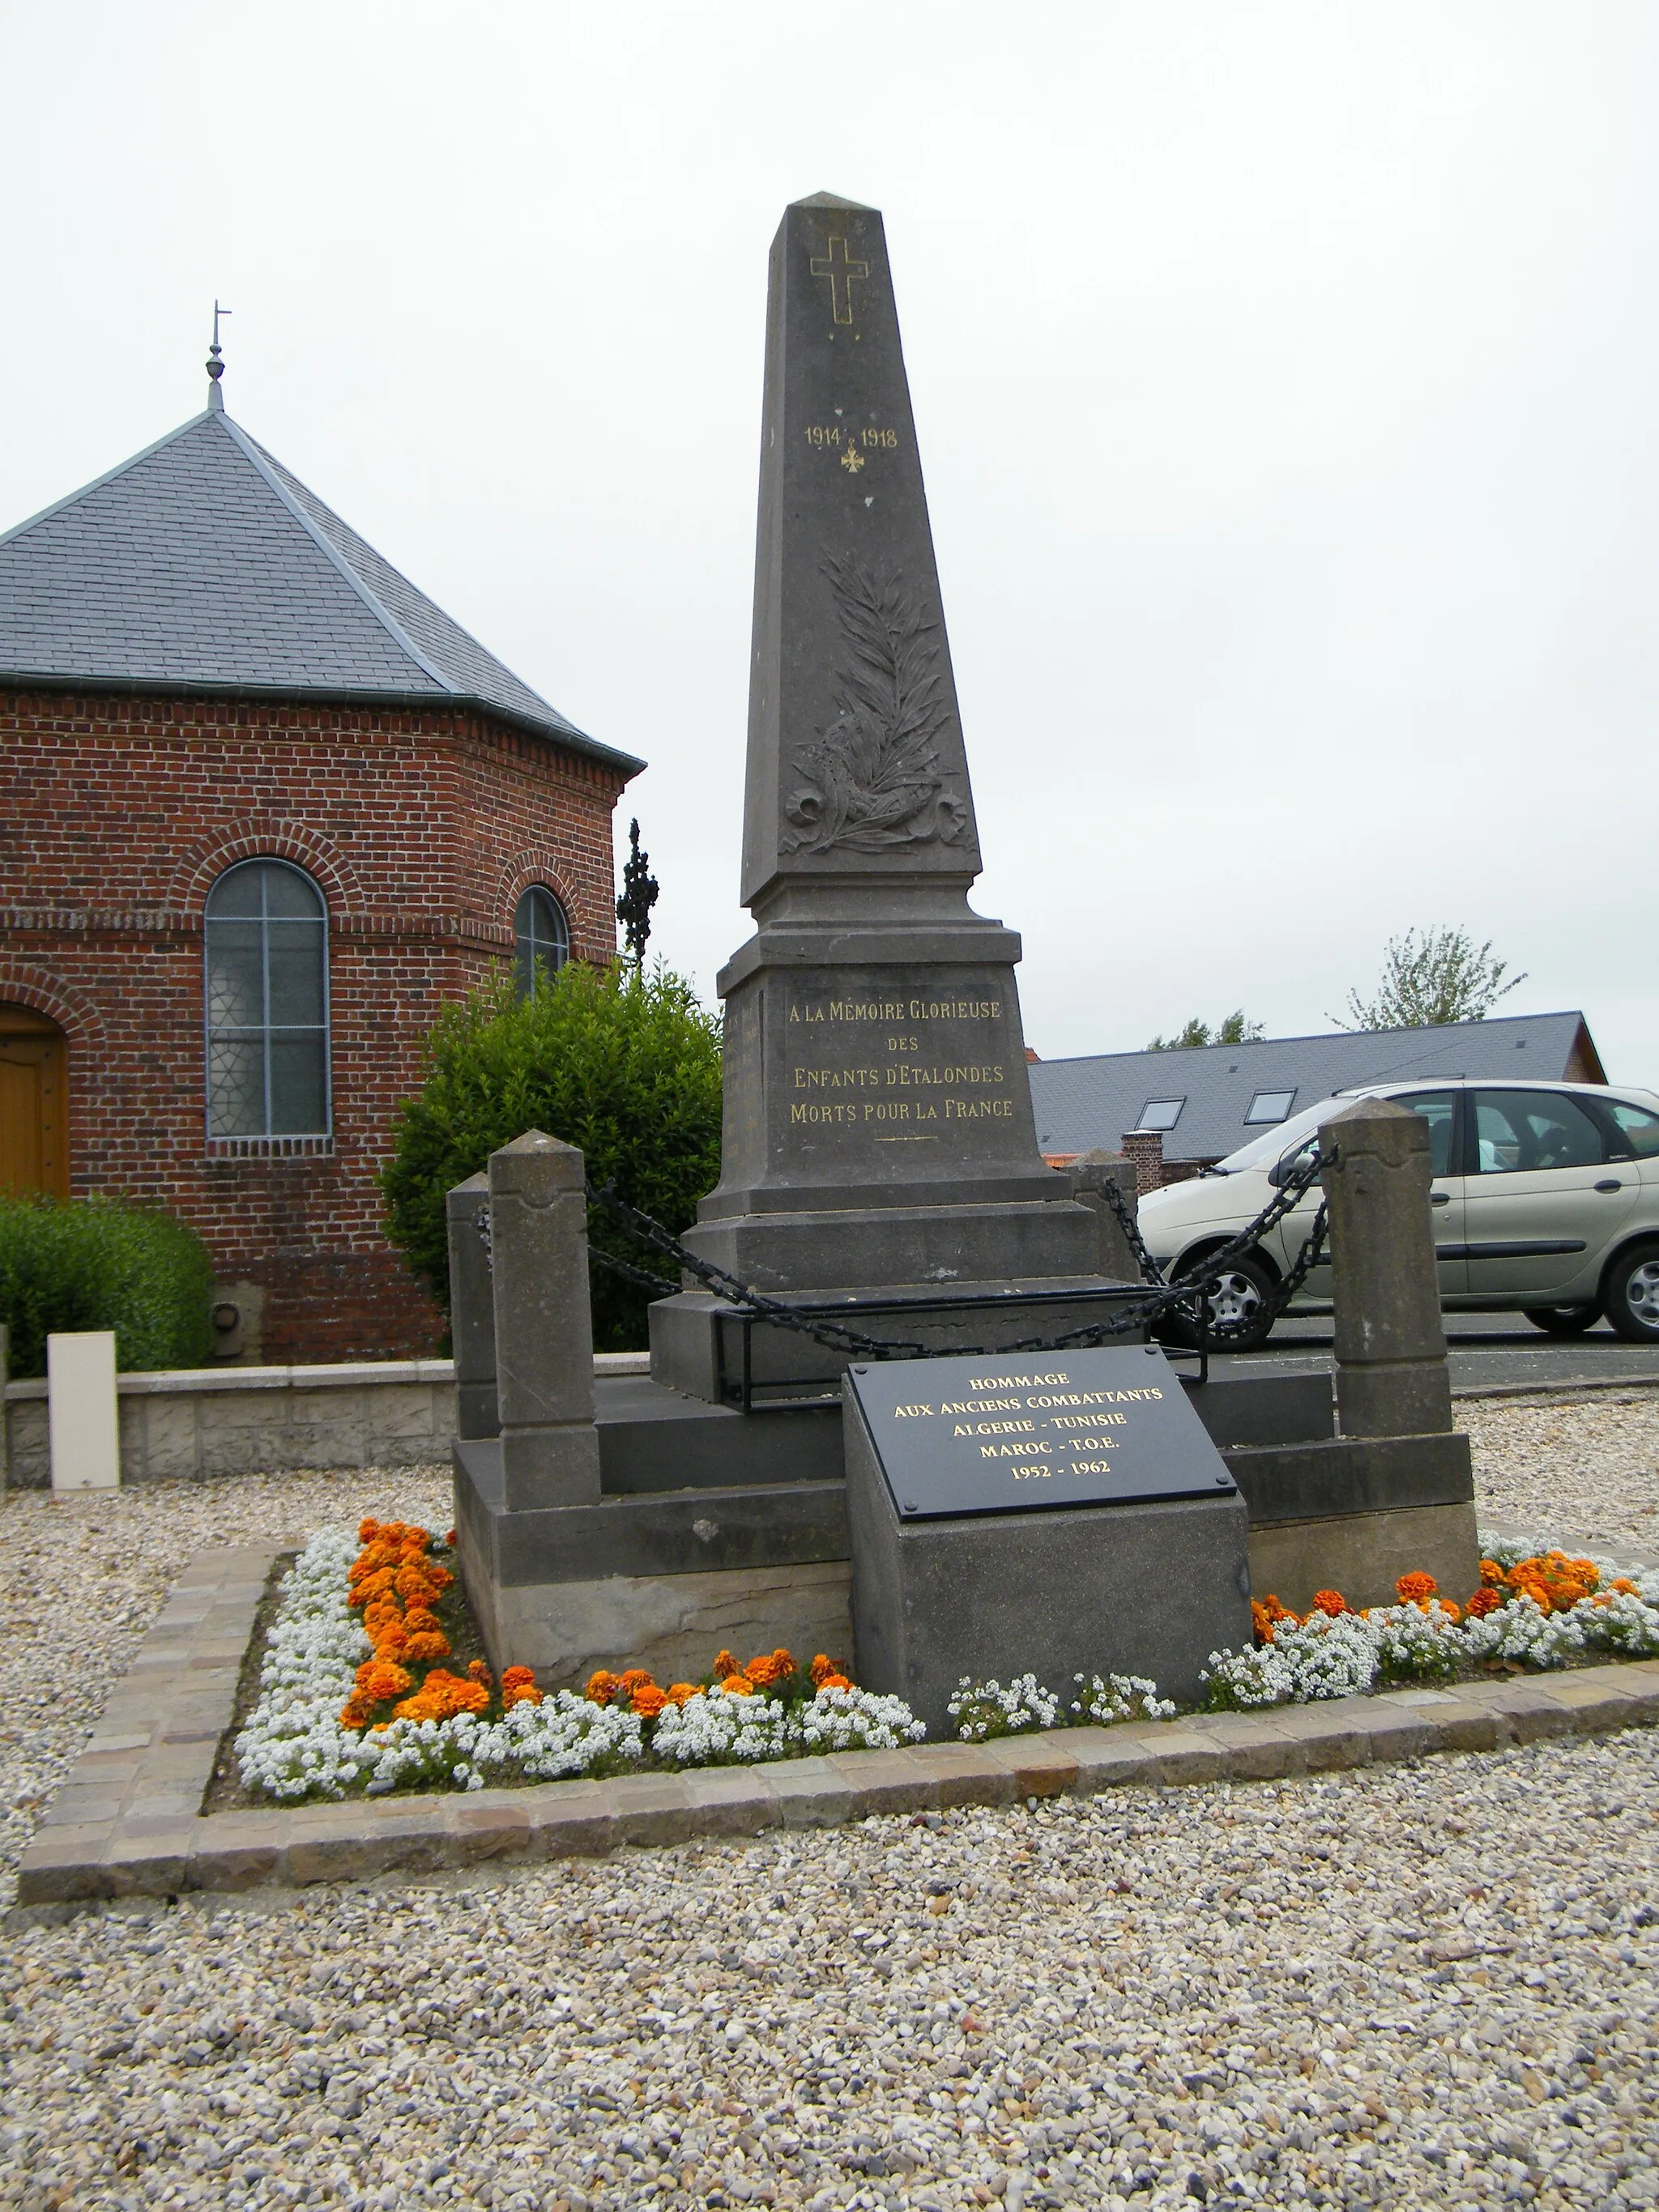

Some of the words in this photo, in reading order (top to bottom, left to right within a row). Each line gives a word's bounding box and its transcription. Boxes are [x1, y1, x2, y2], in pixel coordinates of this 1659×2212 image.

[804, 427, 840, 445] 1914
[861, 428, 898, 447] 1918
[789, 1004, 800, 1021] A
[804, 1005, 825, 1021] LA
[910, 998, 1001, 1019] GLORIEUSE
[888, 1038, 919, 1051] DES
[794, 1068, 879, 1088] ENFANTS
[791, 1102, 857, 1123] MORTS
[864, 1104, 909, 1120] POUR
[916, 1103, 937, 1119] LA
[945, 1099, 1012, 1118] FRANCE
[969, 1373, 1070, 1391] HOMMAGE
[893, 1404, 934, 1418] AUX
[940, 1397, 1021, 1415] ANCIENS
[1027, 1387, 1163, 1409] COMBATTANTS
[953, 1419, 1035, 1437] ALGERIE
[1051, 1413, 1127, 1430] TUNISIE
[979, 1441, 1052, 1458] MAROC
[1068, 1436, 1120, 1451] T.O.E.
[1011, 1465, 1051, 1480] 1952
[1071, 1460, 1110, 1475] 1962
